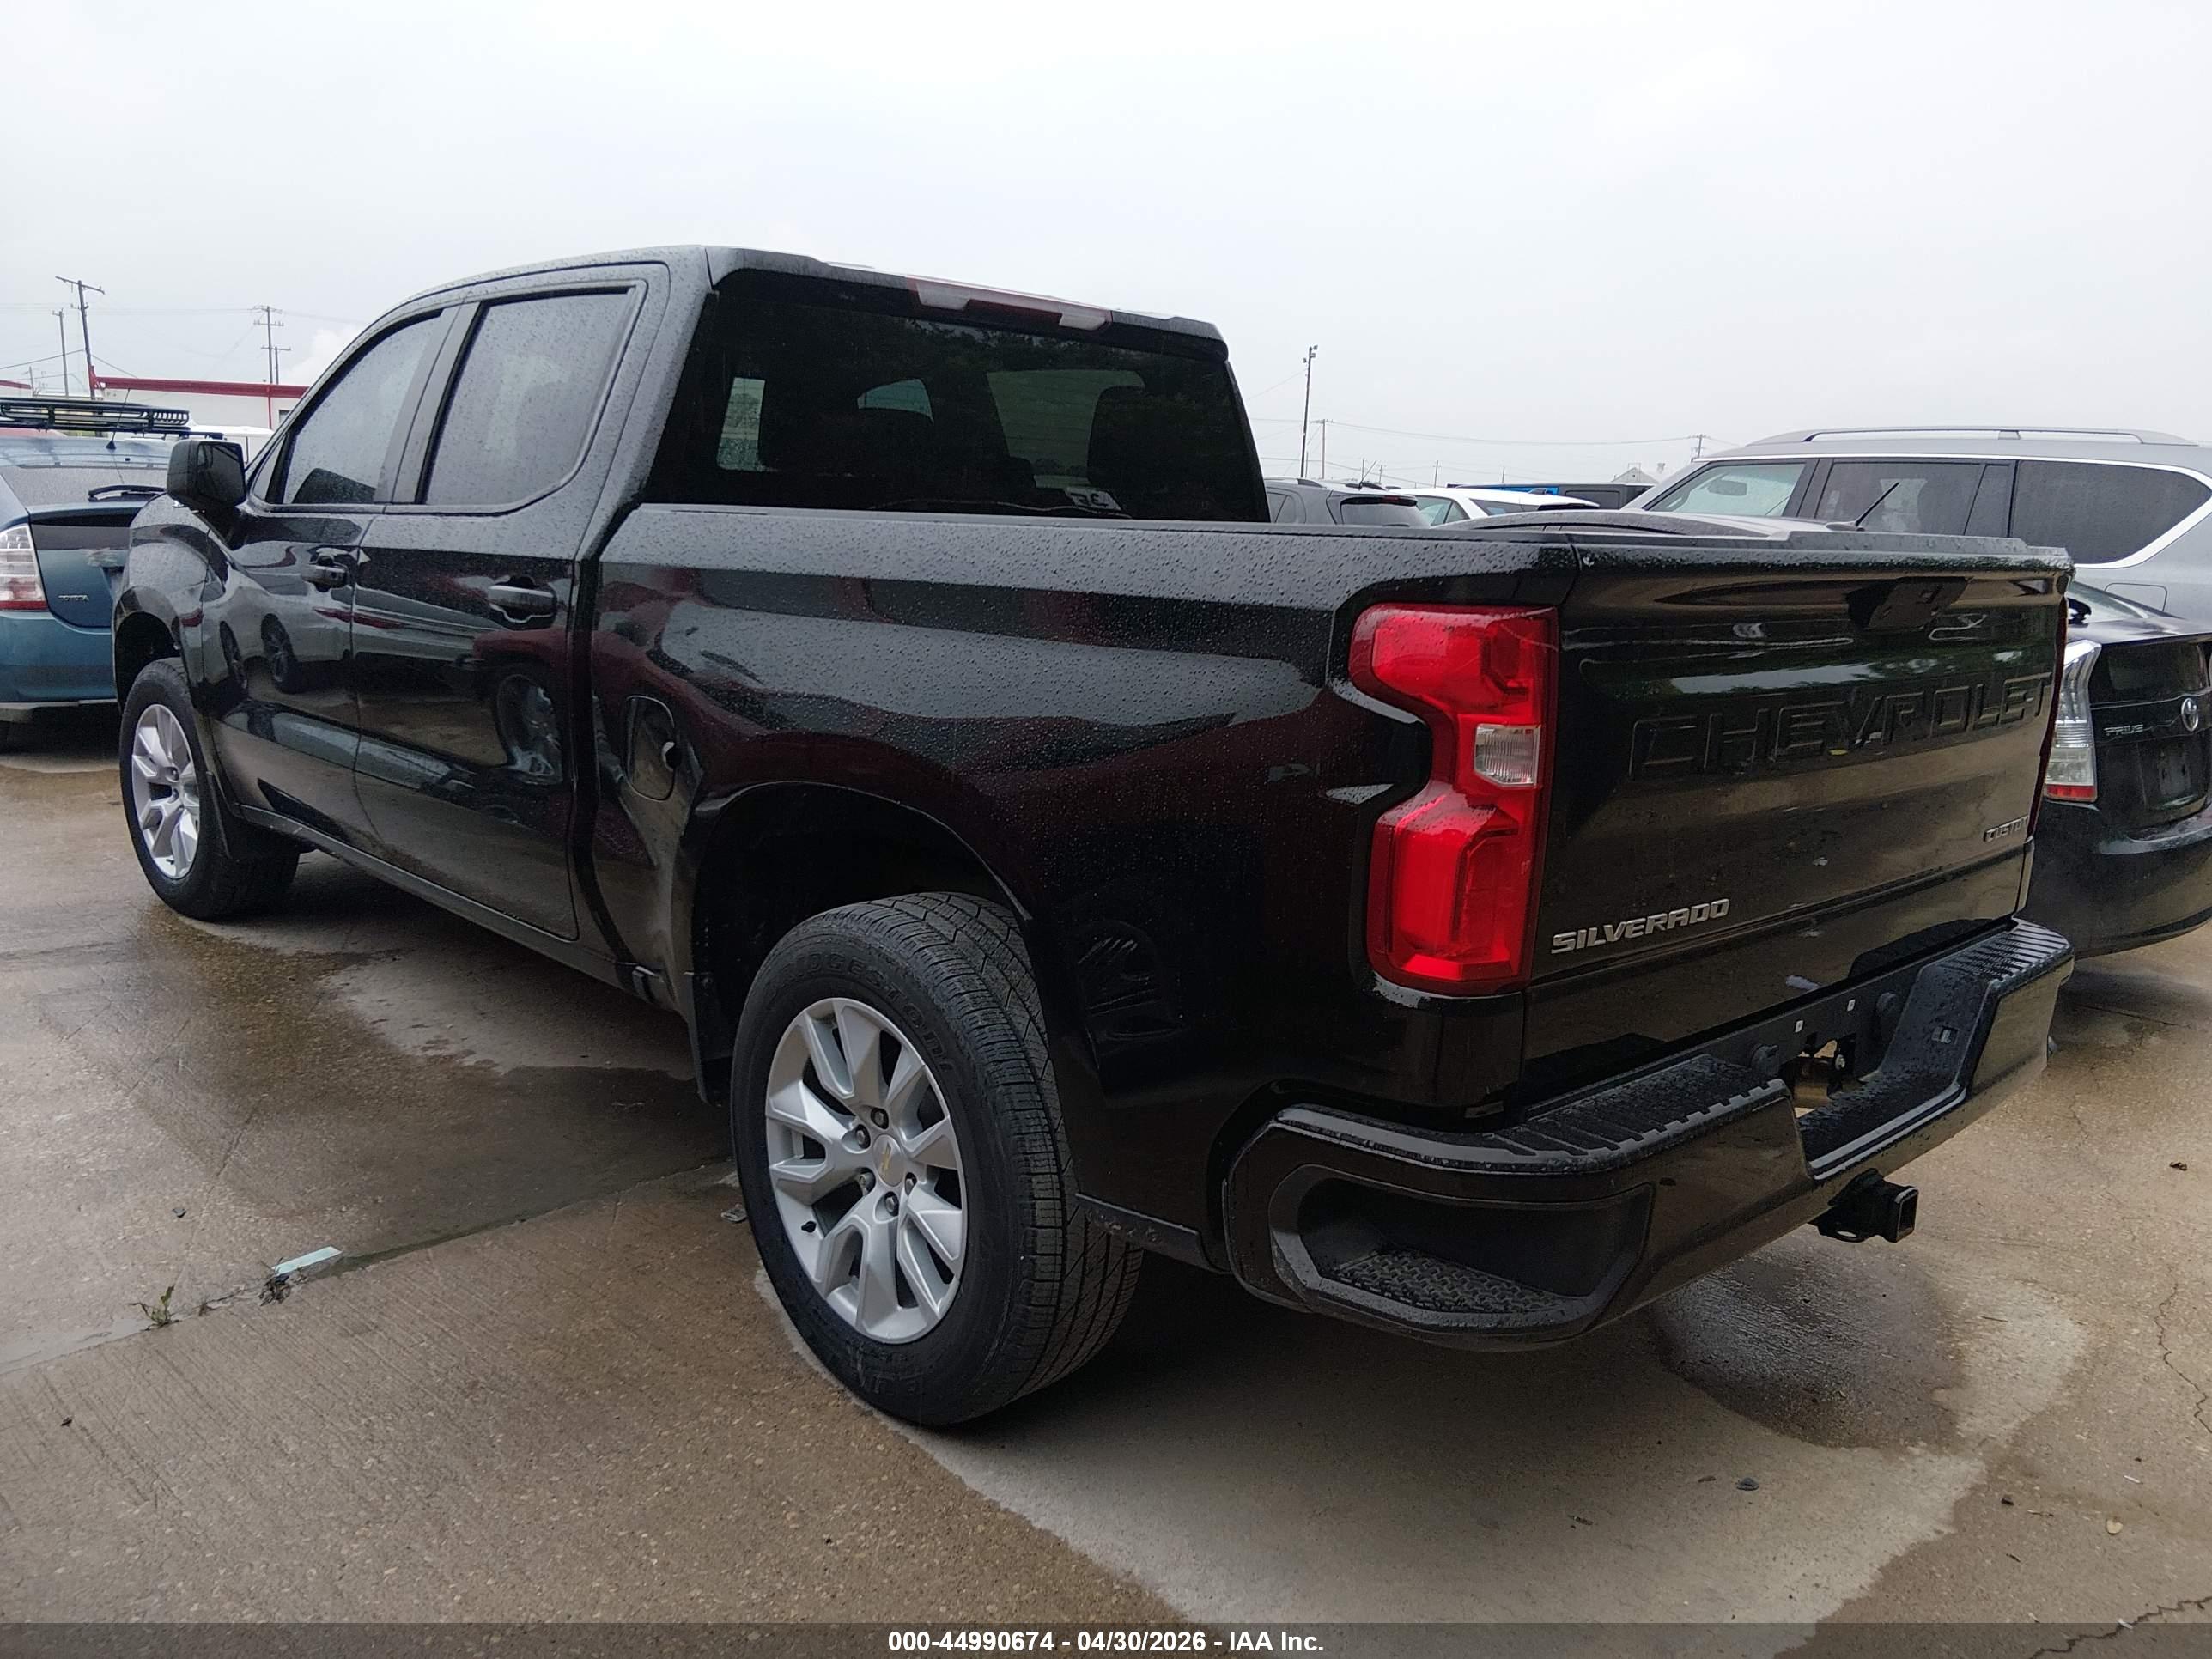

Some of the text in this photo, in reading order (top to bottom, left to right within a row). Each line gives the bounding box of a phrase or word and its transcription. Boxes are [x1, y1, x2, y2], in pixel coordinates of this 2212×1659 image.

[1628, 672, 2054, 776] CHEVROLET
[2104, 724, 2144, 737] PRIUS
[1551, 898, 1730, 954] SILVERADO
